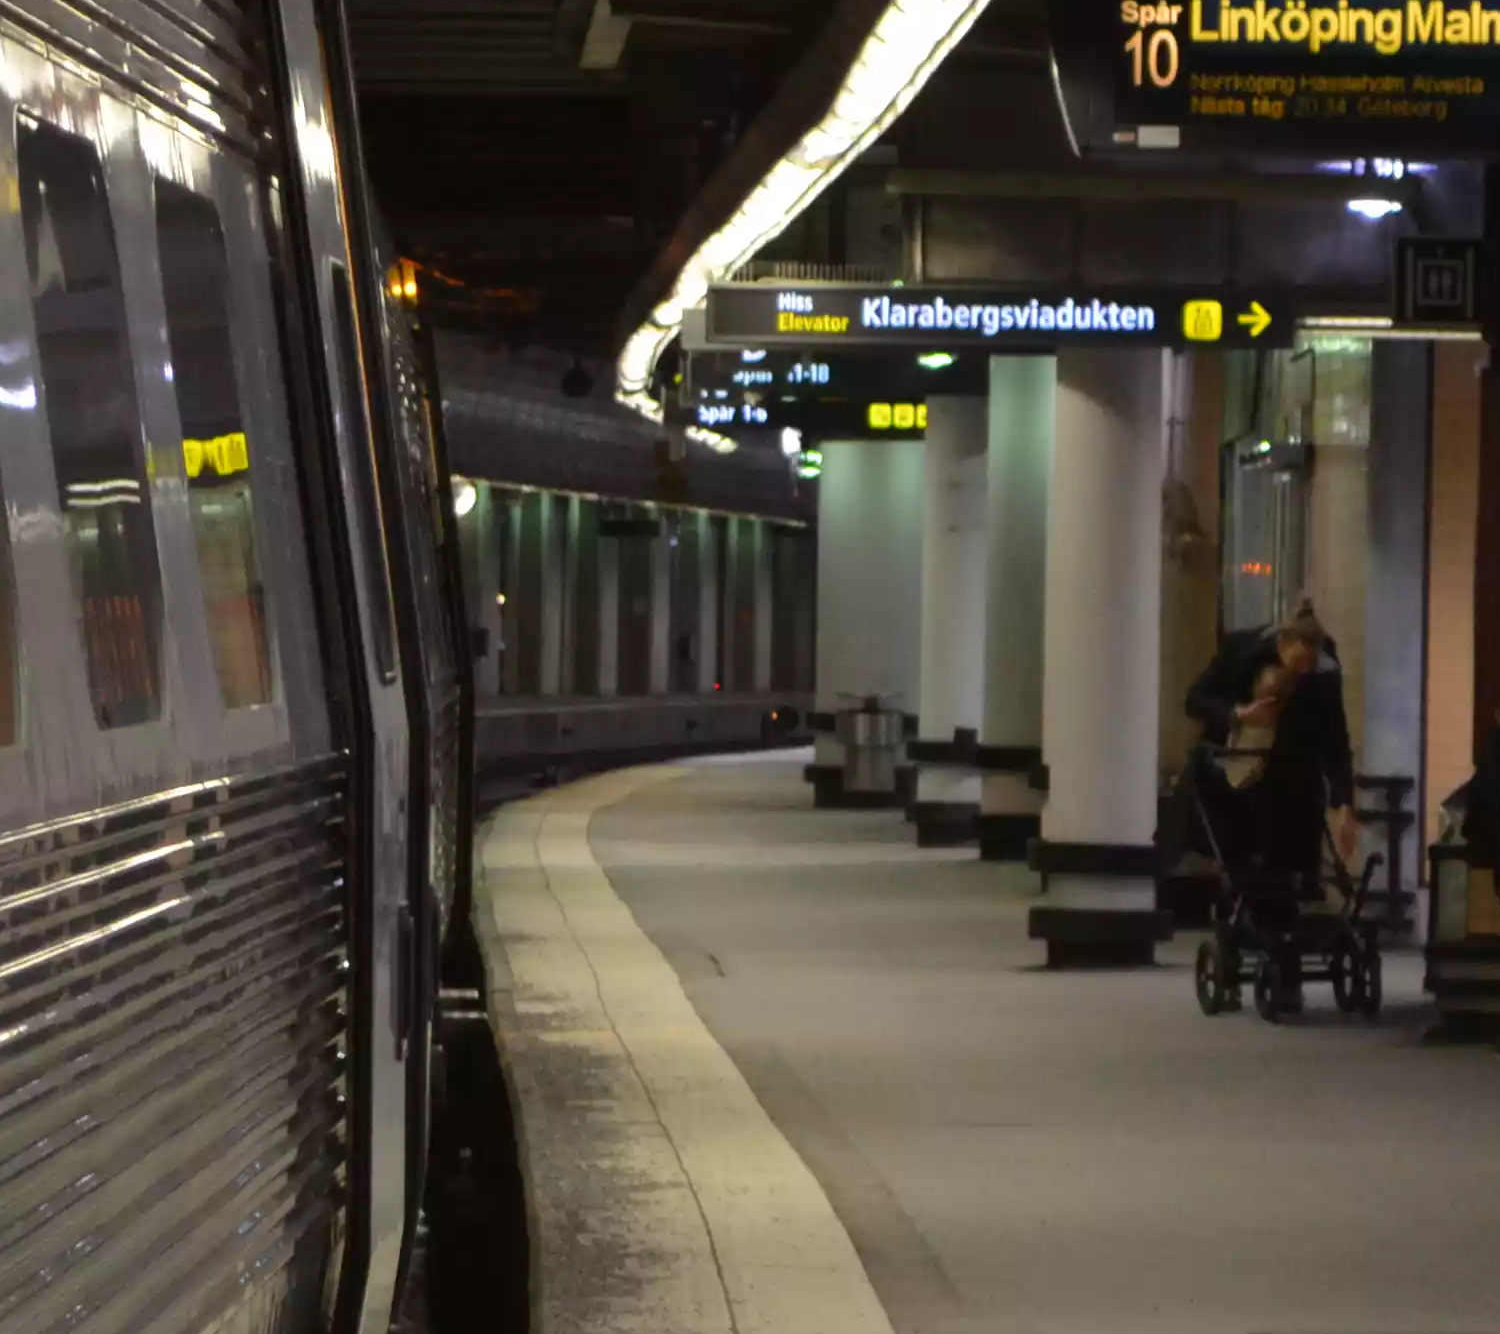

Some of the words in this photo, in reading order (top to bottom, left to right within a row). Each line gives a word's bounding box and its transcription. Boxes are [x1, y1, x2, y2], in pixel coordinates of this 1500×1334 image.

[1124, 29, 1179, 87] 10
[778, 291, 814, 312] Hiss
[862, 295, 1155, 336] Klarabergsviadukten
[778, 312, 849, 333] Elevator
